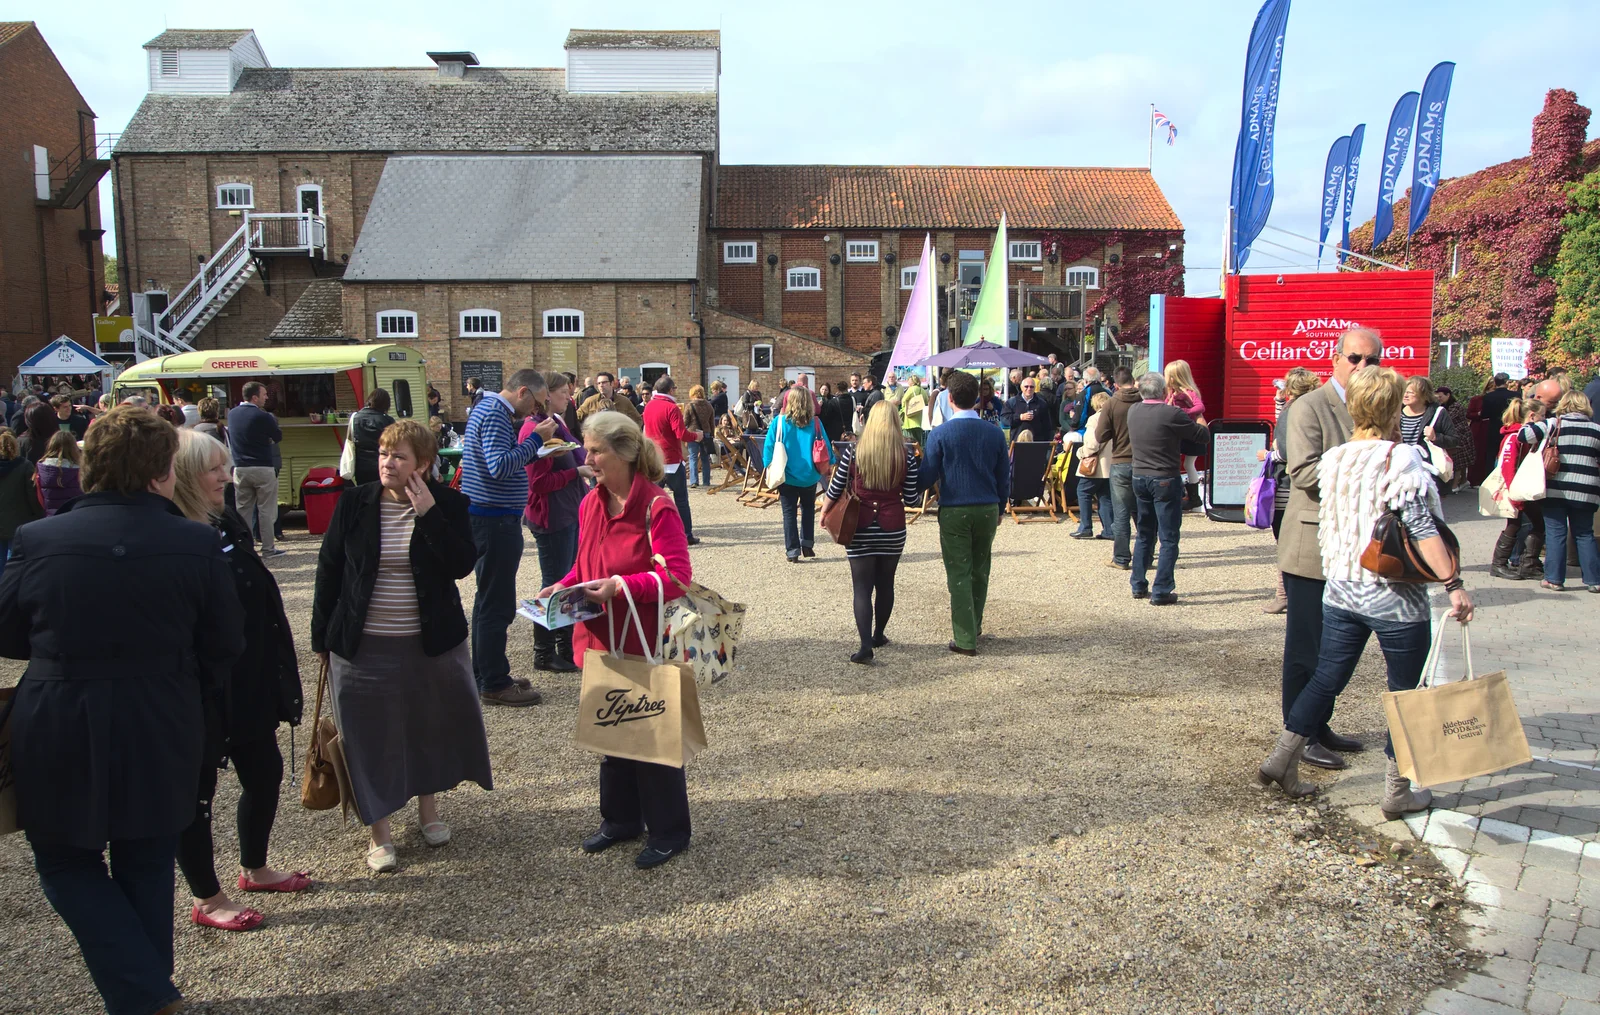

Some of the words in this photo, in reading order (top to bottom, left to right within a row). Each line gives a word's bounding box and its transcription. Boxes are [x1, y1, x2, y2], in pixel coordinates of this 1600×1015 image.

[1250, 85, 1263, 143] ADNAMS
[1418, 101, 1442, 189] ADNAMS
[1382, 127, 1408, 204] ADNAMS
[1324, 165, 1343, 228] ADNAMS
[1292, 318, 1360, 336] ADNAMS
[211, 360, 258, 369] CREPERIE
[594, 688, 666, 727] Tiptree
[1442, 716, 1478, 730] Aldeburgh
[1458, 729, 1482, 740] festival
